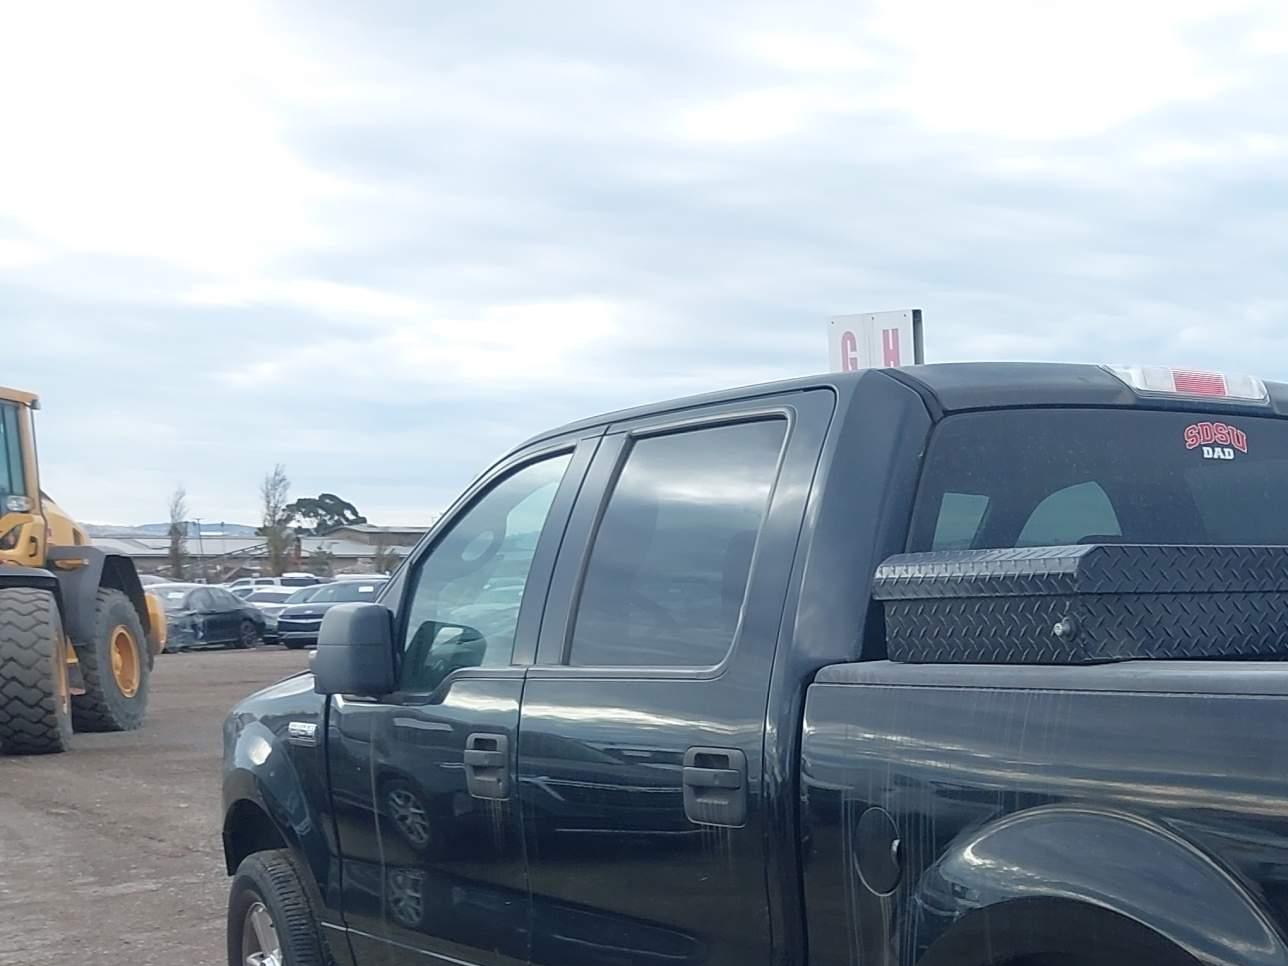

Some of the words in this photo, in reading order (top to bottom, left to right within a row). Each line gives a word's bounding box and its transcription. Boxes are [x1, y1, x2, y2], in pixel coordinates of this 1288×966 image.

[841, 331, 858, 371] G
[882, 328, 900, 367] H
[1184, 422, 1247, 453] SDSU
[1202, 446, 1234, 459] DAD
